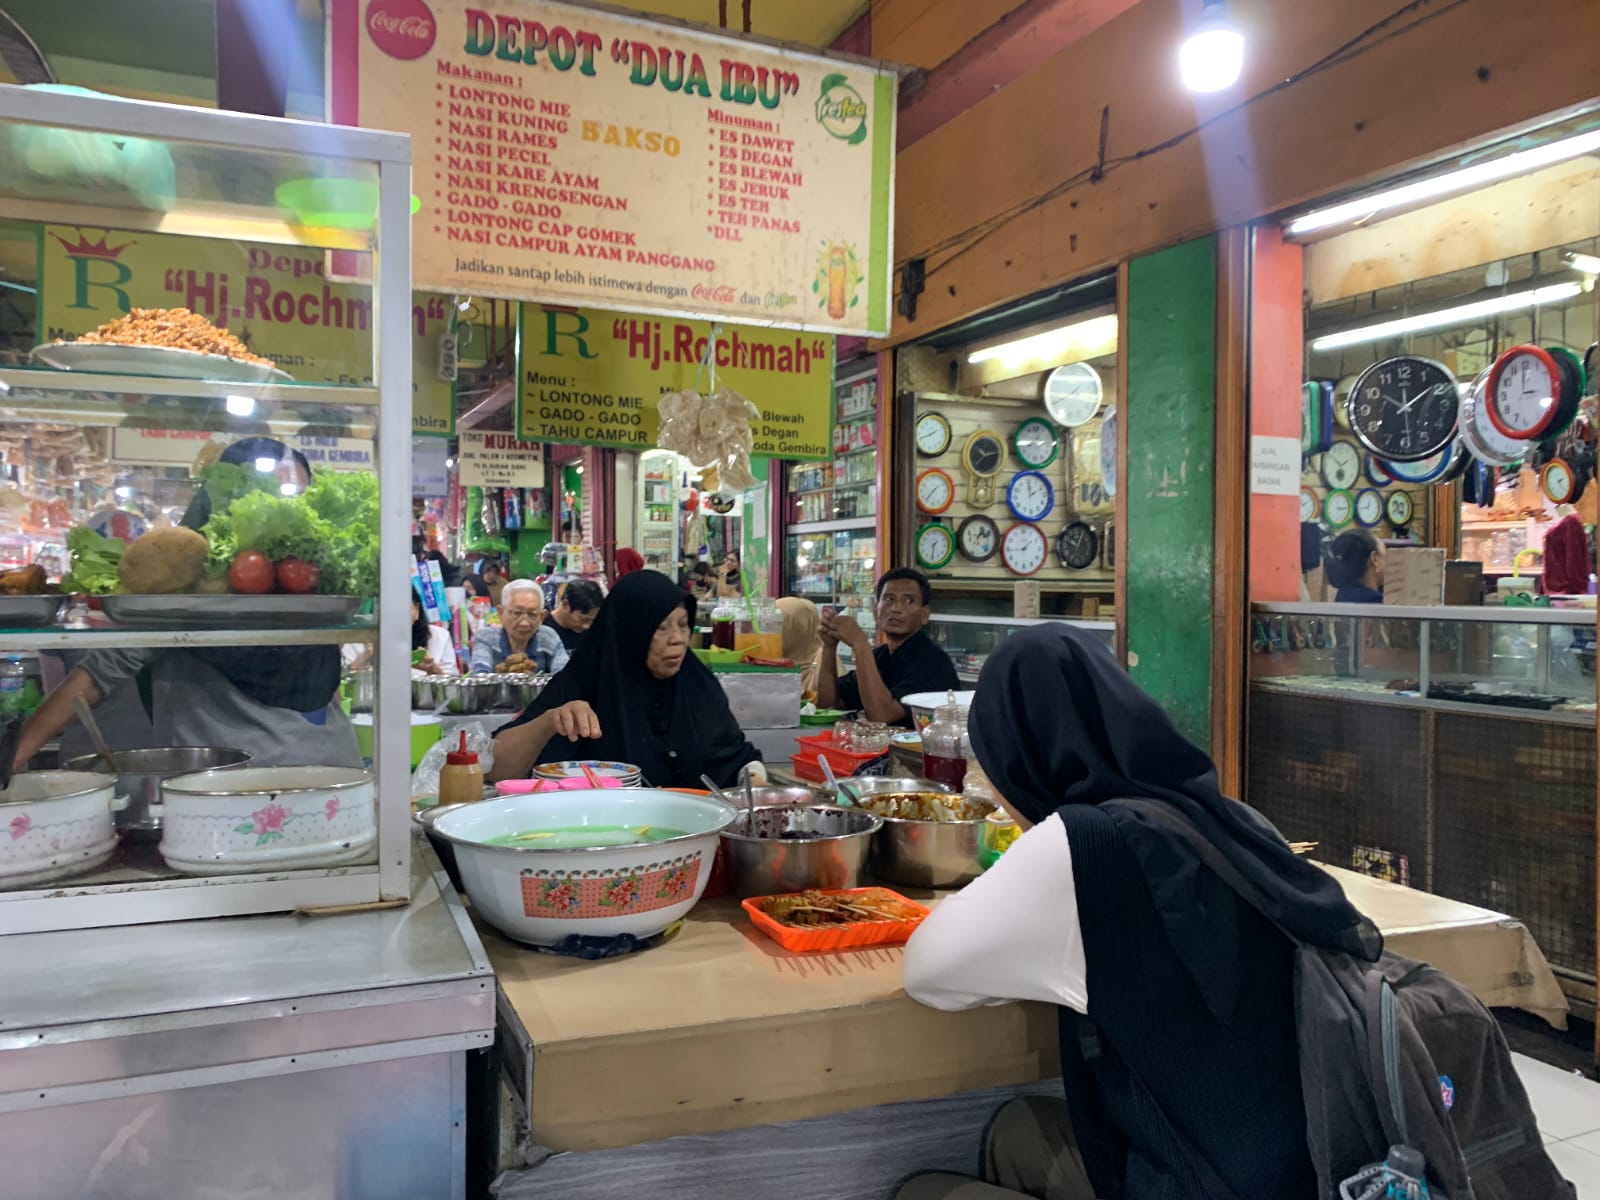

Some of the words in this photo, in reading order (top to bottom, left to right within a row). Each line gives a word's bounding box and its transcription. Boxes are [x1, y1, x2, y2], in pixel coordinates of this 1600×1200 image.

[463, 8, 602, 76] DEPOT
[437, 59, 514, 86] Makanan
[449, 85, 534, 111] LONTONG
[540, 102, 570, 117] MIE
[449, 103, 492, 122] NASI
[497, 112, 568, 133] KUNING
[707, 107, 773, 131] Minuman
[449, 121, 492, 140] NASI
[497, 130, 557, 150] RAMES
[582, 119, 681, 157] BAKSO
[719, 129, 737, 143] ES
[742, 133, 795, 153] DAWET
[449, 138, 492, 158] NASI
[497, 148, 551, 166] PECEL
[719, 145, 737, 159] ES
[742, 149, 793, 167] DEGAN
[448, 156, 491, 175] NASI
[497, 164, 546, 182] KARE
[551, 172, 599, 190] AYAM
[719, 162, 737, 175] ES
[741, 165, 802, 186] BLEWAH
[448, 174, 491, 193] NASI
[496, 180, 628, 210] KRENGSENGAN
[718, 178, 736, 192] ES
[740, 180, 789, 200] JERUK
[447, 192, 499, 210] GADO
[513, 201, 562, 218] GADO
[718, 194, 736, 208] ES
[740, 197, 770, 213] TEH
[448, 209, 533, 232] LONTONG
[539, 221, 572, 238] CAP
[577, 227, 636, 247] GOMEK
[718, 210, 747, 227] TEH
[752, 214, 800, 233] PANAS
[714, 226, 742, 242] DLL
[447, 227, 491, 245] NASI
[496, 233, 569, 254] CAMPUR
[574, 244, 621, 261] AYAM
[627, 250, 715, 272] PANGGANG
[249, 248, 324, 277] Depo
[65, 254, 133, 312] R
[455, 257, 504, 275] Jadikan
[507, 265, 550, 284] santap
[555, 269, 585, 284] lebih
[589, 275, 642, 292] istimewa
[646, 281, 687, 297] dengan
[740, 291, 760, 305] dan
[540, 309, 598, 361] R
[527, 371, 567, 388] Menu
[1379, 373, 1392, 385] 11
[1397, 366, 1412, 379] 12
[540, 389, 613, 409] LONTONG
[618, 395, 643, 410] MIE
[1365, 387, 1380, 400] 10
[540, 407, 584, 422] GADO
[598, 411, 641, 426] GADO
[763, 411, 804, 424] Blewah
[1360, 404, 1371, 417] 9
[540, 424, 579, 440] TAHU
[584, 427, 648, 443] CAMPUR
[762, 425, 799, 440] Degan
[753, 441, 775, 452] oda
[779, 441, 826, 455] Gembira
